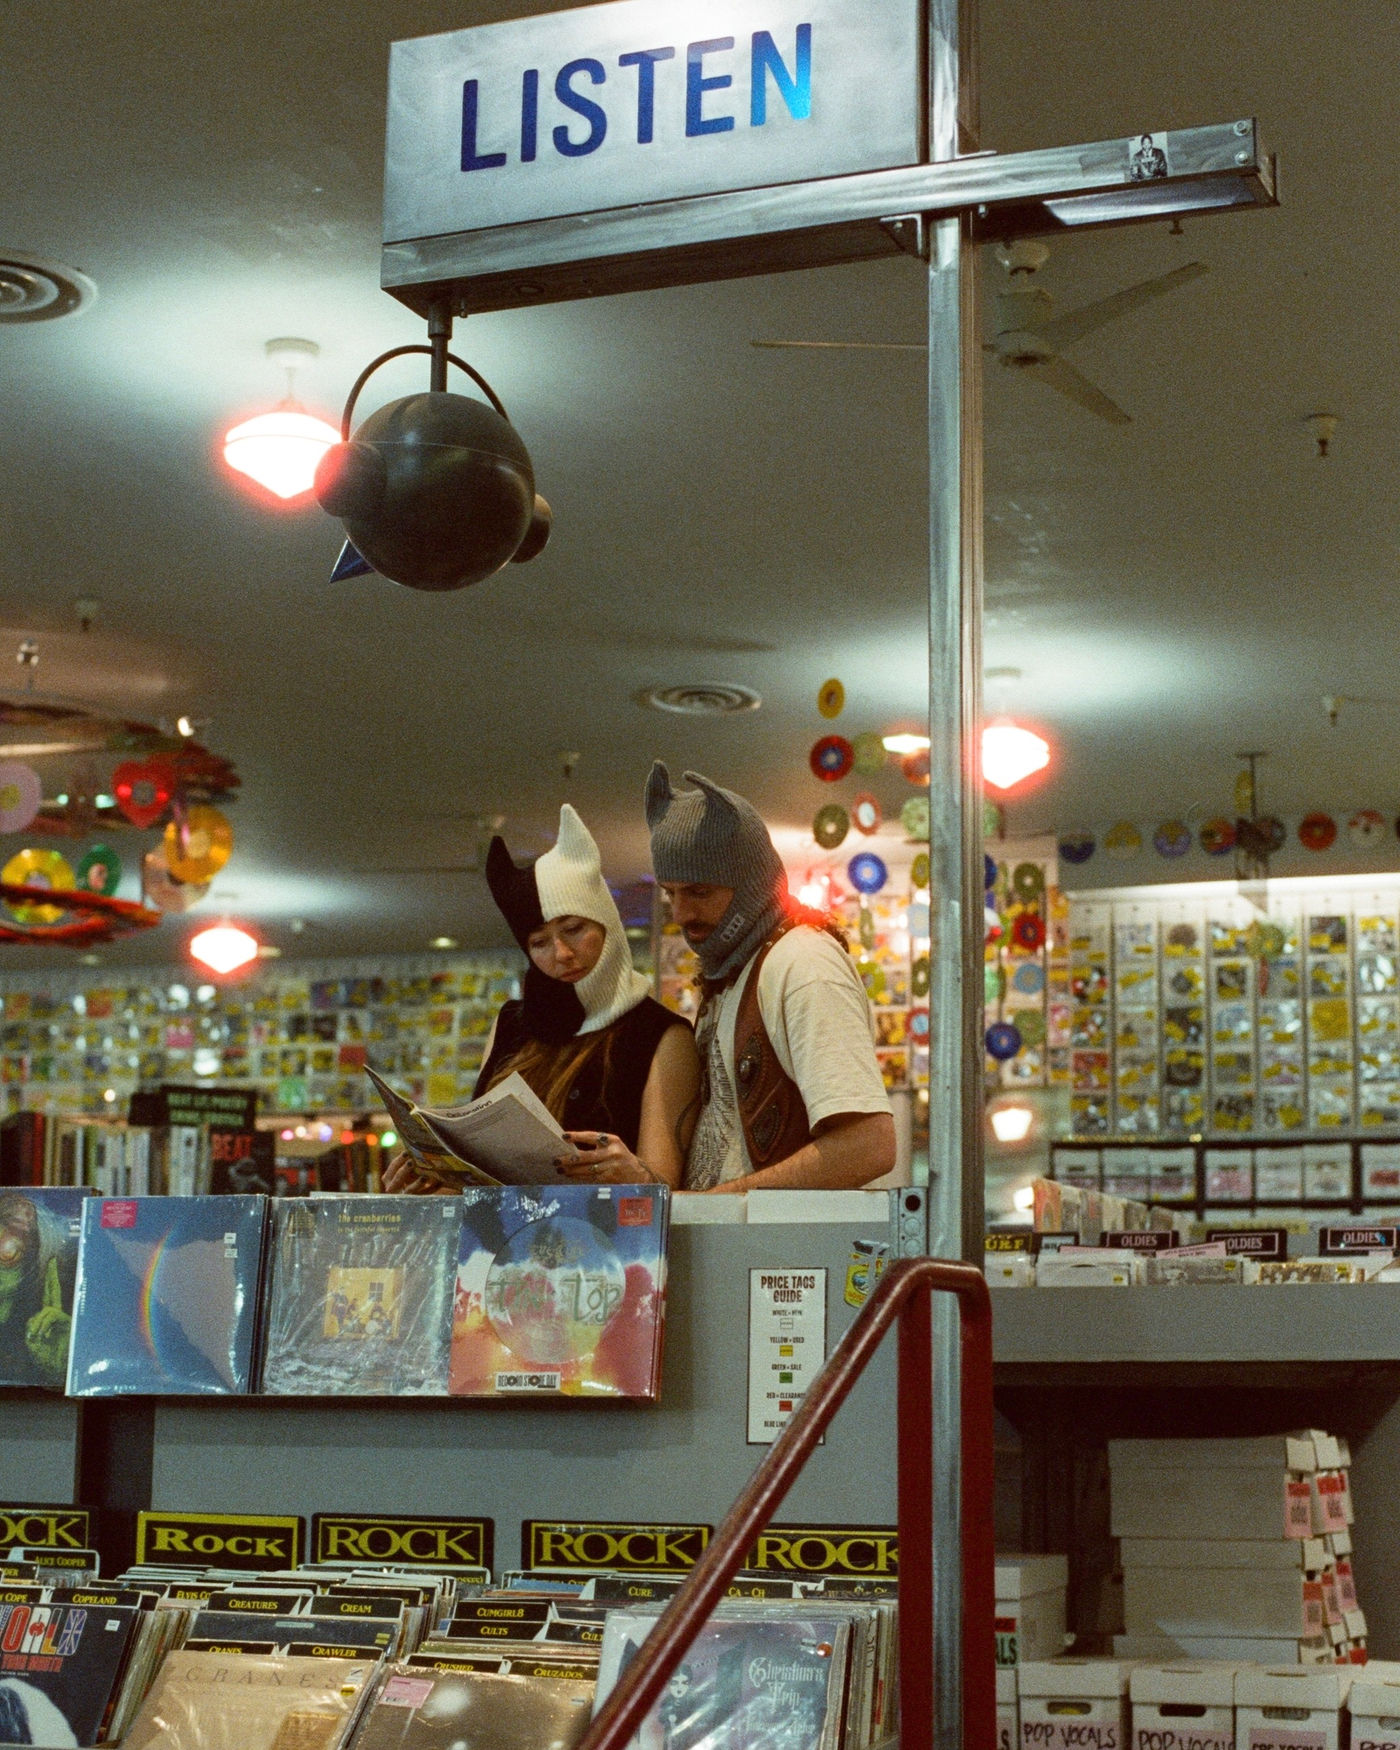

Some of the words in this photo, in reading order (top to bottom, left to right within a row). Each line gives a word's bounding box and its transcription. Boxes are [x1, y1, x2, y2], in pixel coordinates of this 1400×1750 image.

[460, 22, 812, 172] LISTEN
[1121, 1235, 1158, 1247] OLDIES
[1227, 1237, 1262, 1250] OLDIES
[1343, 1232, 1380, 1245] OLDIES
[761, 1276, 789, 1289] PRICE
[792, 1276, 815, 1289] TAGS
[773, 1290, 802, 1303] GUIDE
[152, 1527, 286, 1558] ROCK
[326, 1525, 475, 1561] ROCK
[540, 1532, 695, 1566] ROCK
[35, 1556, 54, 1566] ALICE
[55, 1556, 86, 1567] COOPER
[5, 1592, 28, 1603] COPE
[176, 1590, 198, 1600] ELVIS
[628, 1586, 653, 1598] CURE
[728, 1587, 741, 1598] CA
[751, 1587, 765, 1598] CH
[72, 1593, 118, 1605] COPELAND
[228, 1598, 278, 1610] CREATURES
[339, 1602, 373, 1614] CREAM
[476, 1607, 525, 1618] CUMGIRL8
[480, 1625, 509, 1636] CULTS
[208, 1645, 242, 1655] CRANES
[311, 1646, 357, 1658] CRAWLER
[433, 1661, 474, 1673] CRUSHED
[533, 1667, 584, 1679] CRUZADOS
[185, 1666, 338, 1690] CRANES
[1023, 1723, 1054, 1747] POP
[1060, 1725, 1116, 1749] VOCALS
[1138, 1730, 1175, 1750] POP
